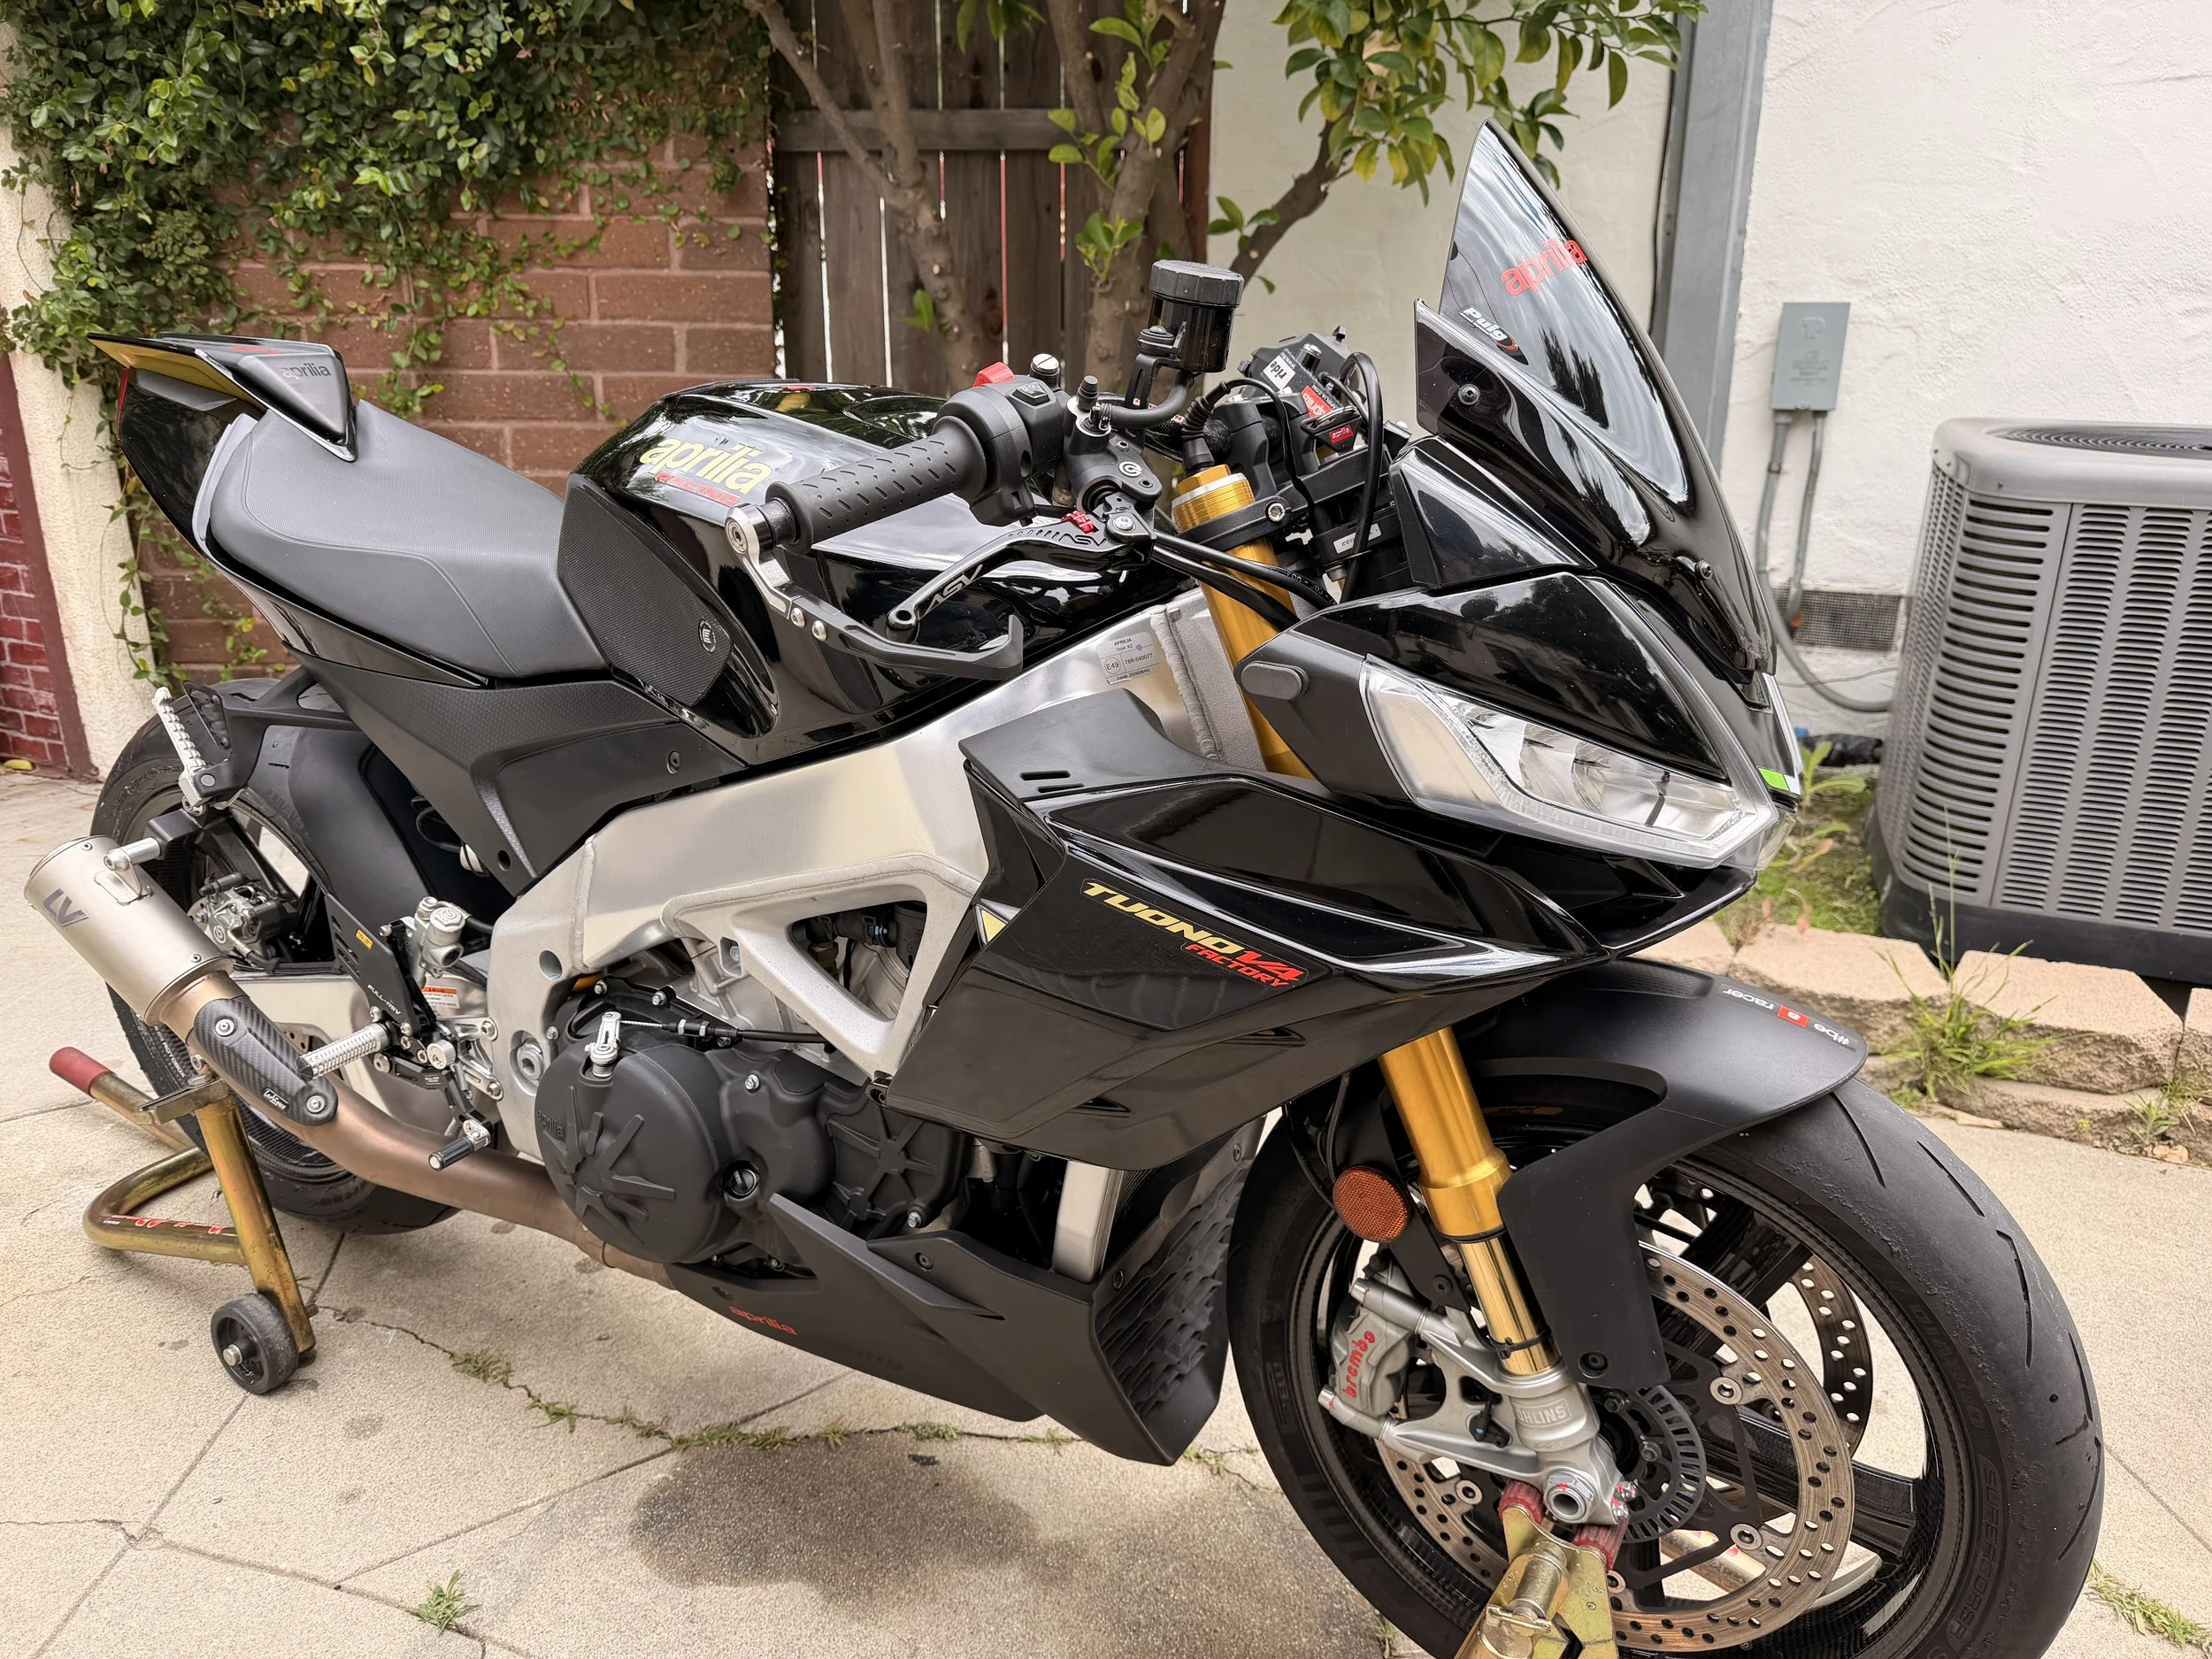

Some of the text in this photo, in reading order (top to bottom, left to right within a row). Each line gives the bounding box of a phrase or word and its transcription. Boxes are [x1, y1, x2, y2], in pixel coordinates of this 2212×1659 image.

[1500, 238, 1588, 296] aprilia
[280, 363, 332, 381] aprilia
[1270, 360, 1288, 380] ride
[639, 438, 774, 495] aprilia
[654, 471, 741, 509] RACING
[924, 564, 984, 617] ASV
[1114, 638, 1133, 647] APRILIA
[1105, 661, 1120, 671] E49
[42, 887, 88, 926] LV
[1083, 881, 1304, 982] TUONO V4
[1184, 943, 1290, 987] FACTORY
[1722, 987, 1776, 1010] racer
[1813, 1022, 1851, 1046] #be
[728, 1305, 798, 1336] aprilia
[1341, 1330, 1376, 1399] brembo
[1948, 1467, 2001, 1640] SUPERCORSA
